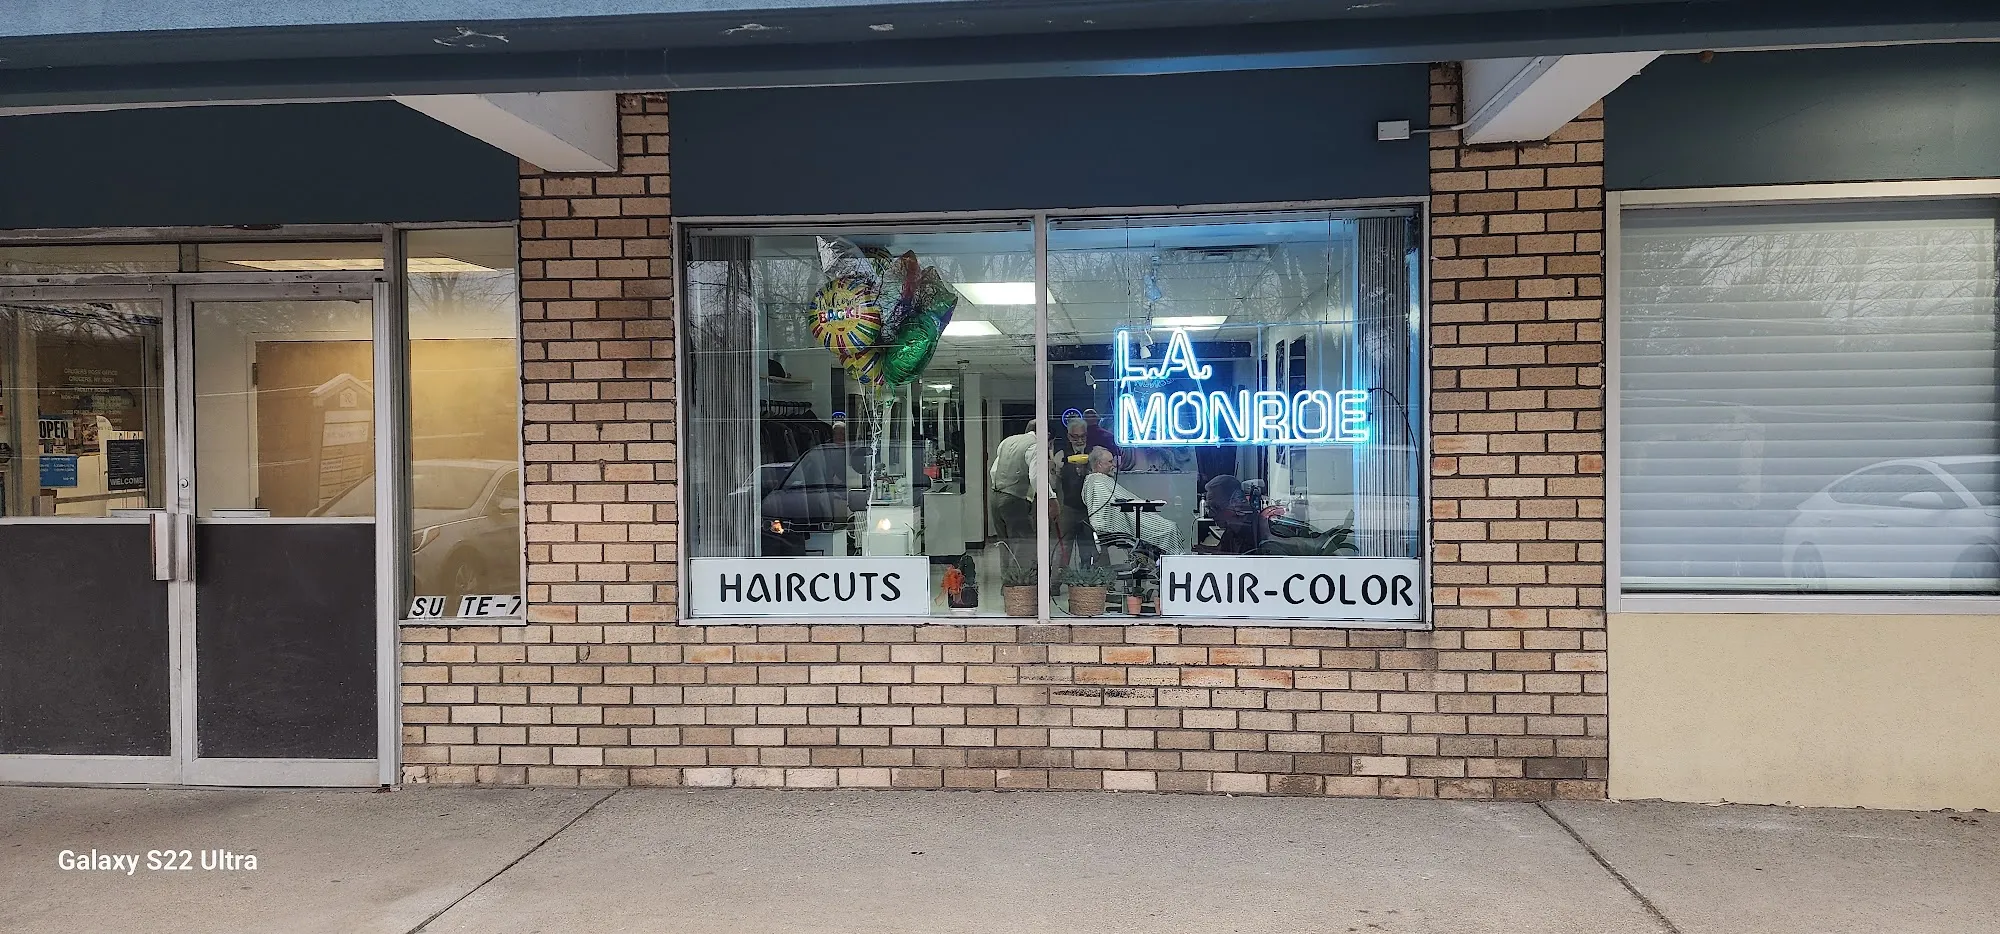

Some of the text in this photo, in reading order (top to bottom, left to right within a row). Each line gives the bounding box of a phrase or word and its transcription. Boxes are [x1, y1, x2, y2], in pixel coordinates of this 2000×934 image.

[819, 306, 860, 324] BACK!
[1118, 389, 1371, 444] MONROE
[39, 420, 69, 439] OPEN
[110, 477, 144, 486] WELCOME
[720, 571, 901, 603] HAIRCUTS
[1169, 571, 1414, 606] HAIR-COLOR
